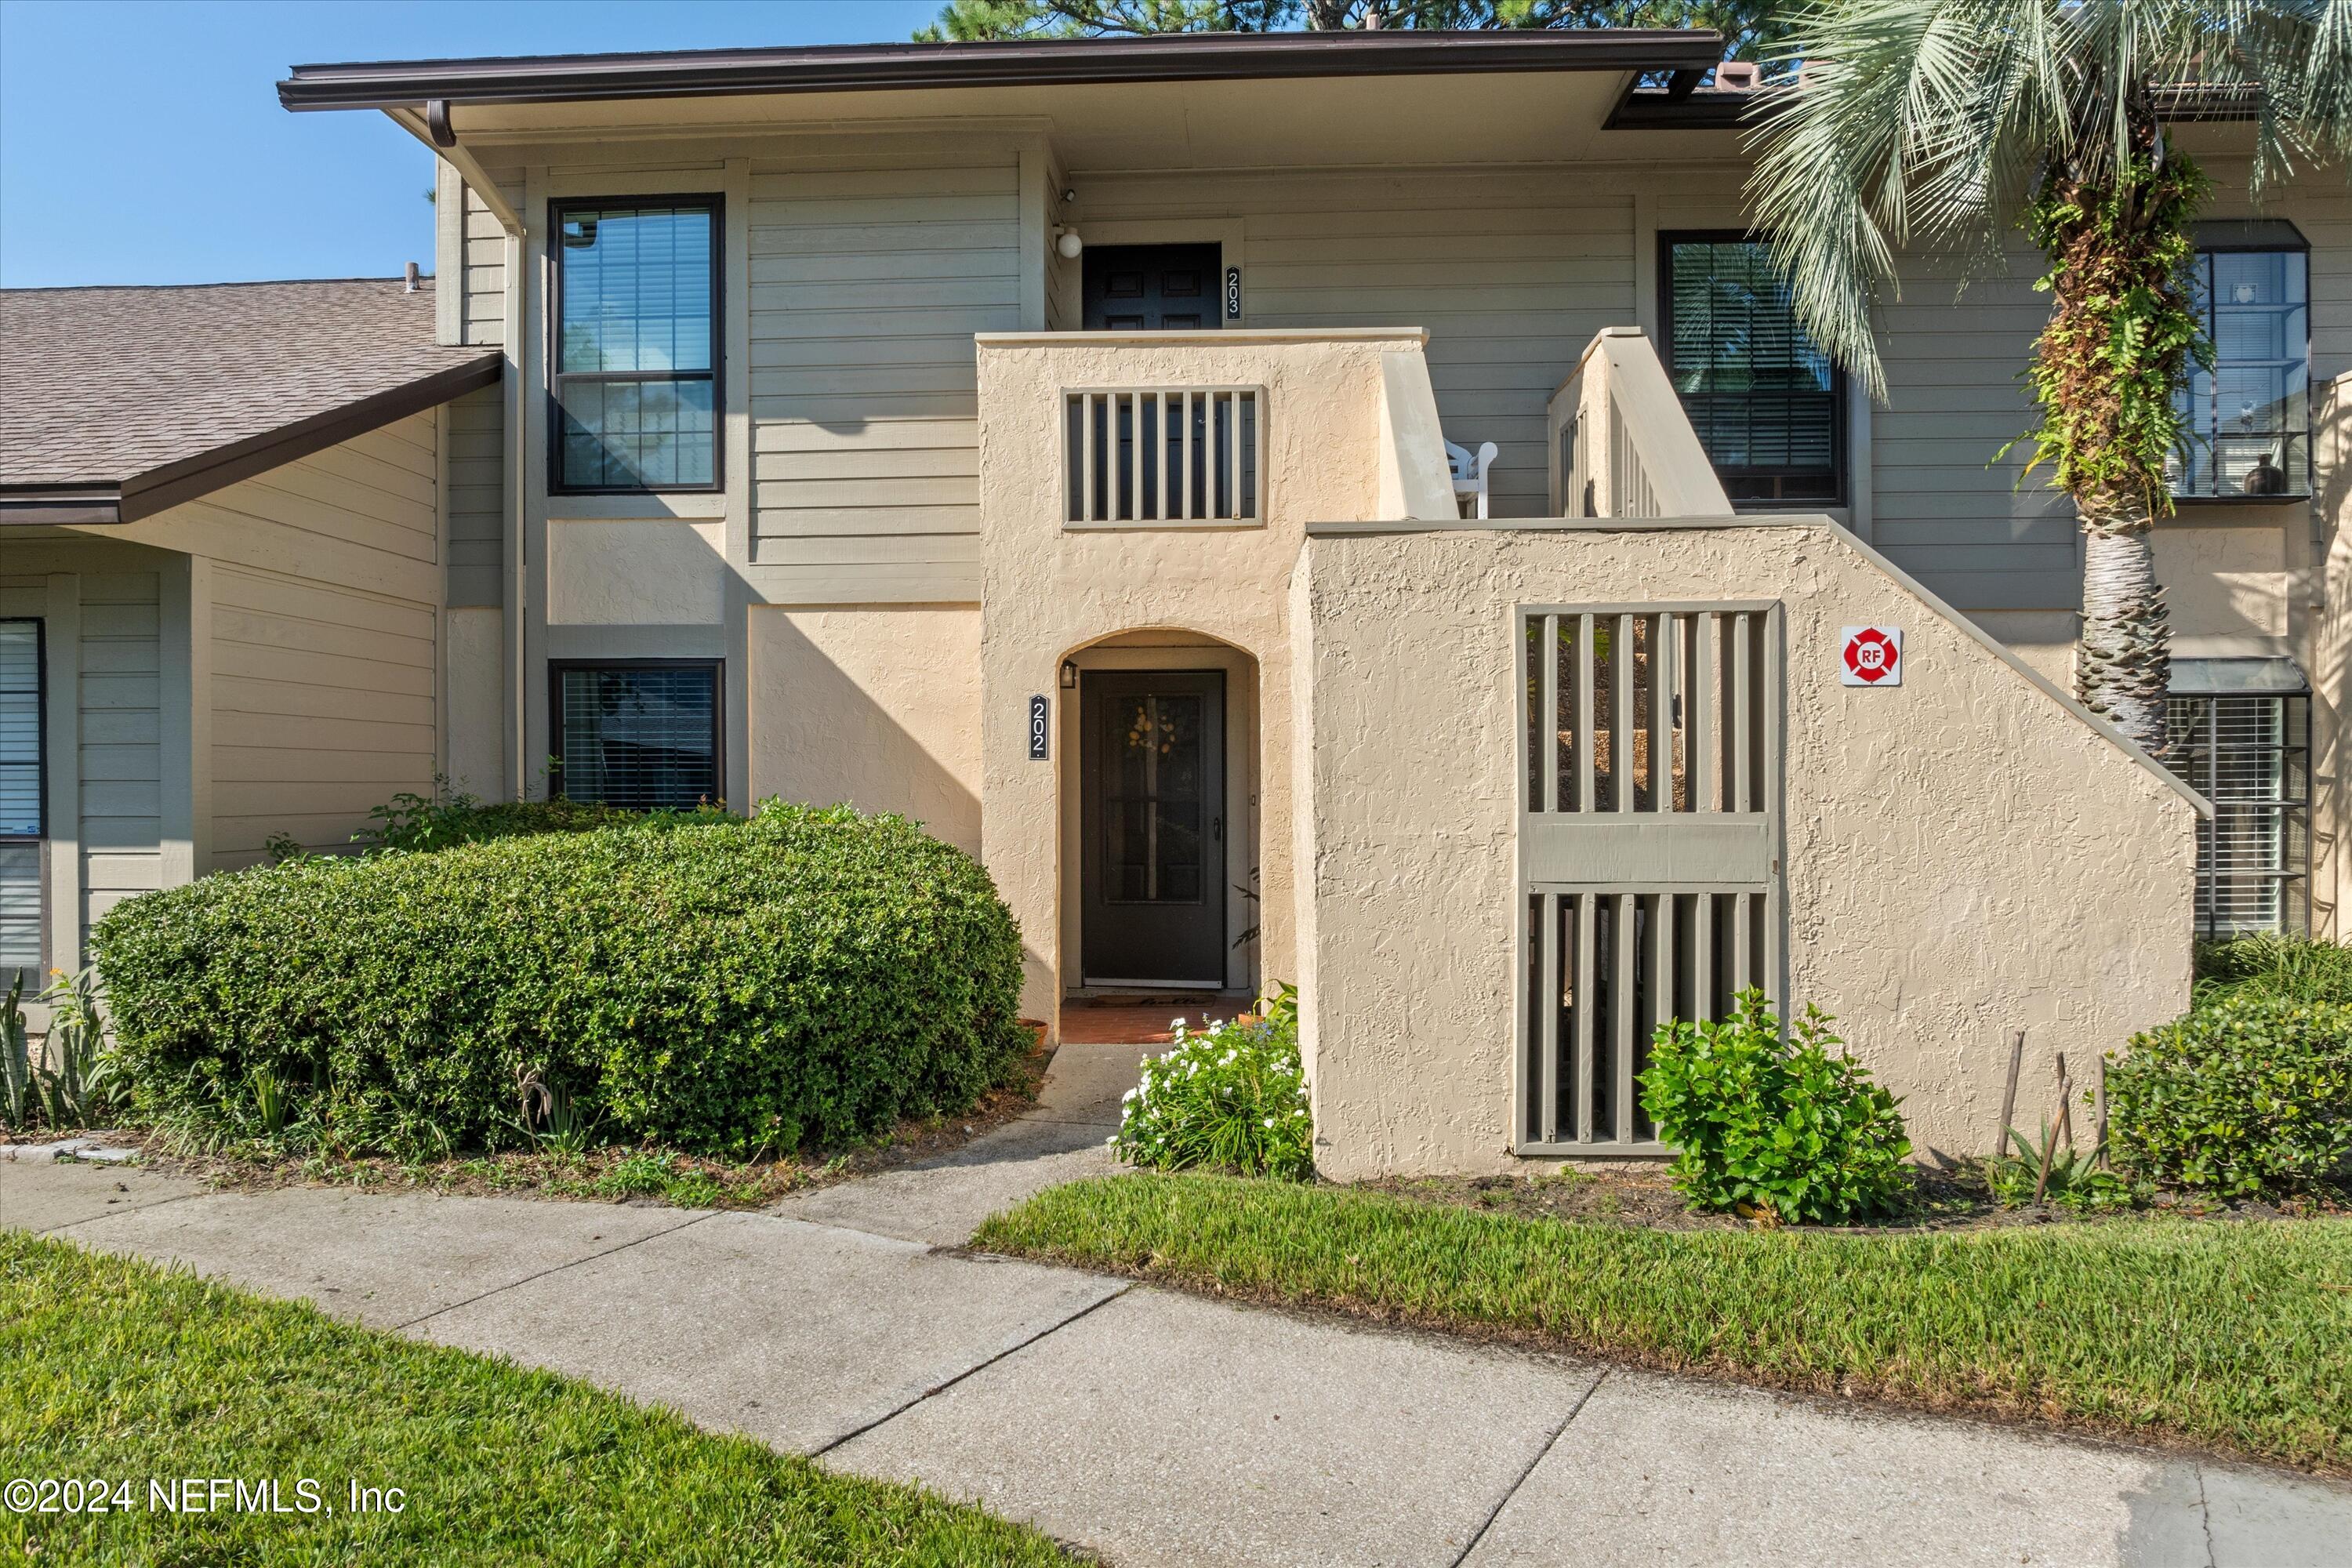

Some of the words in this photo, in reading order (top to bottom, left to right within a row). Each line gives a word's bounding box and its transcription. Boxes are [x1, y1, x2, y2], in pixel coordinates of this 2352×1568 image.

[1229, 273, 1238, 313] 203
[1862, 650, 1881, 663] RF
[1033, 703, 1044, 750] 202
